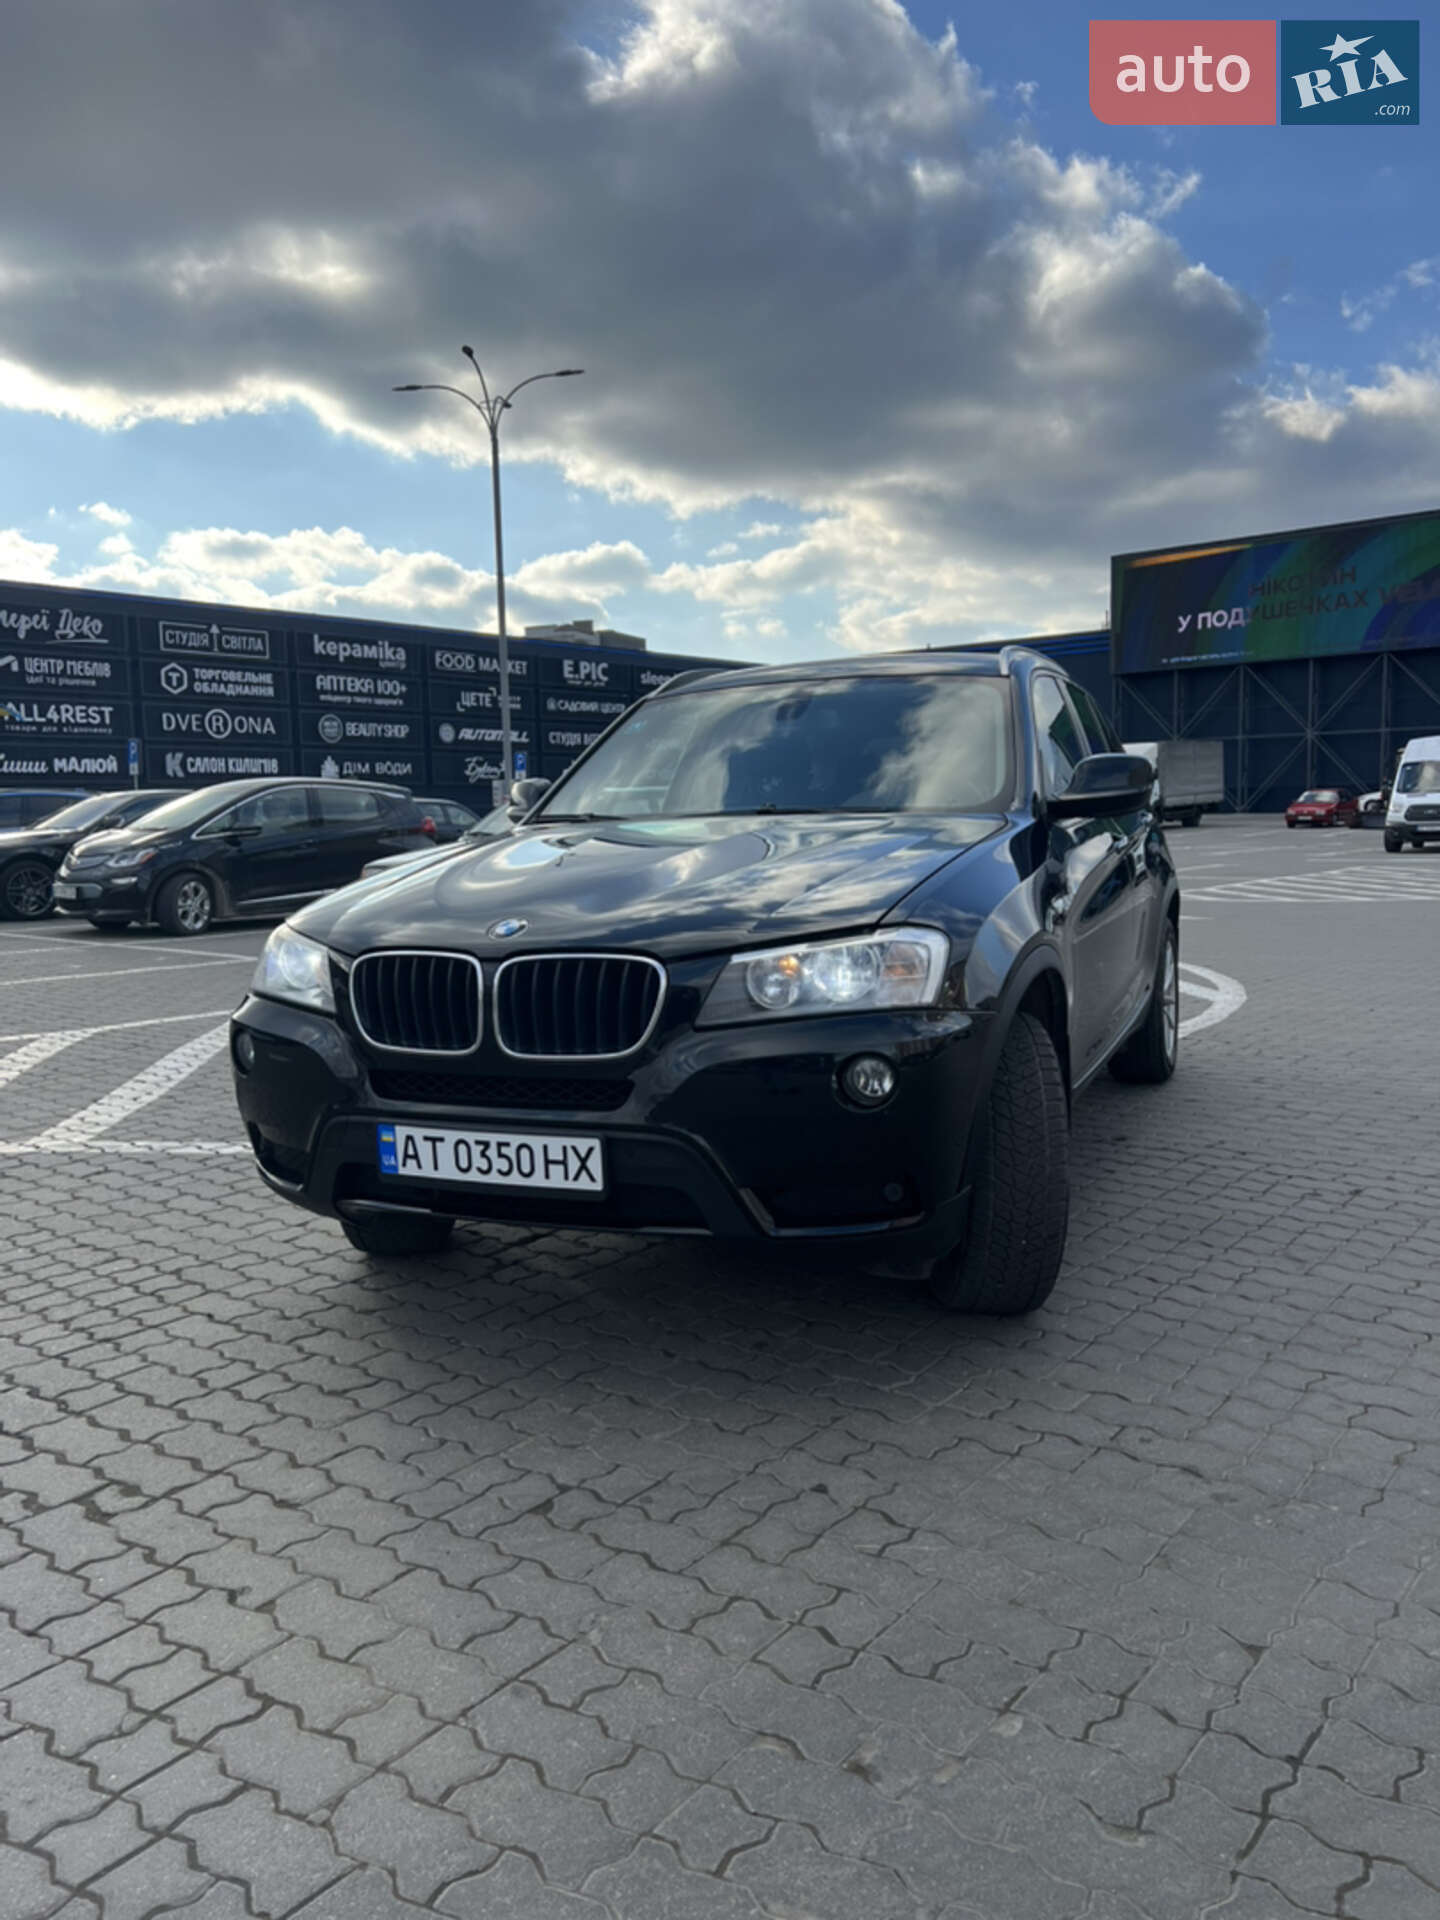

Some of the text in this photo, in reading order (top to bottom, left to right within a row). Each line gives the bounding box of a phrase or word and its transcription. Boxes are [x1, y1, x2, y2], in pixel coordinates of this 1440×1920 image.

[1177, 614, 1192, 633] У
[165, 629, 264, 652] СТУДІЯ СВІТЛА
[24, 657, 111, 678] ЦЕНТР МЕБЛІВ
[434, 651, 528, 675] FOOD MAKET
[192, 668, 274, 684] ТОРГОВЕЛЬНЕ
[316, 674, 408, 696] АПТЕКА 100+
[193, 682, 275, 697] ОБЛАДНАННЯ
[0, 753, 48, 773] иши
[186, 756, 225, 774] САЛОН
[342, 761, 413, 776] ДІМ ВОДИ
[401, 1134, 597, 1183] AT 0350 HX
